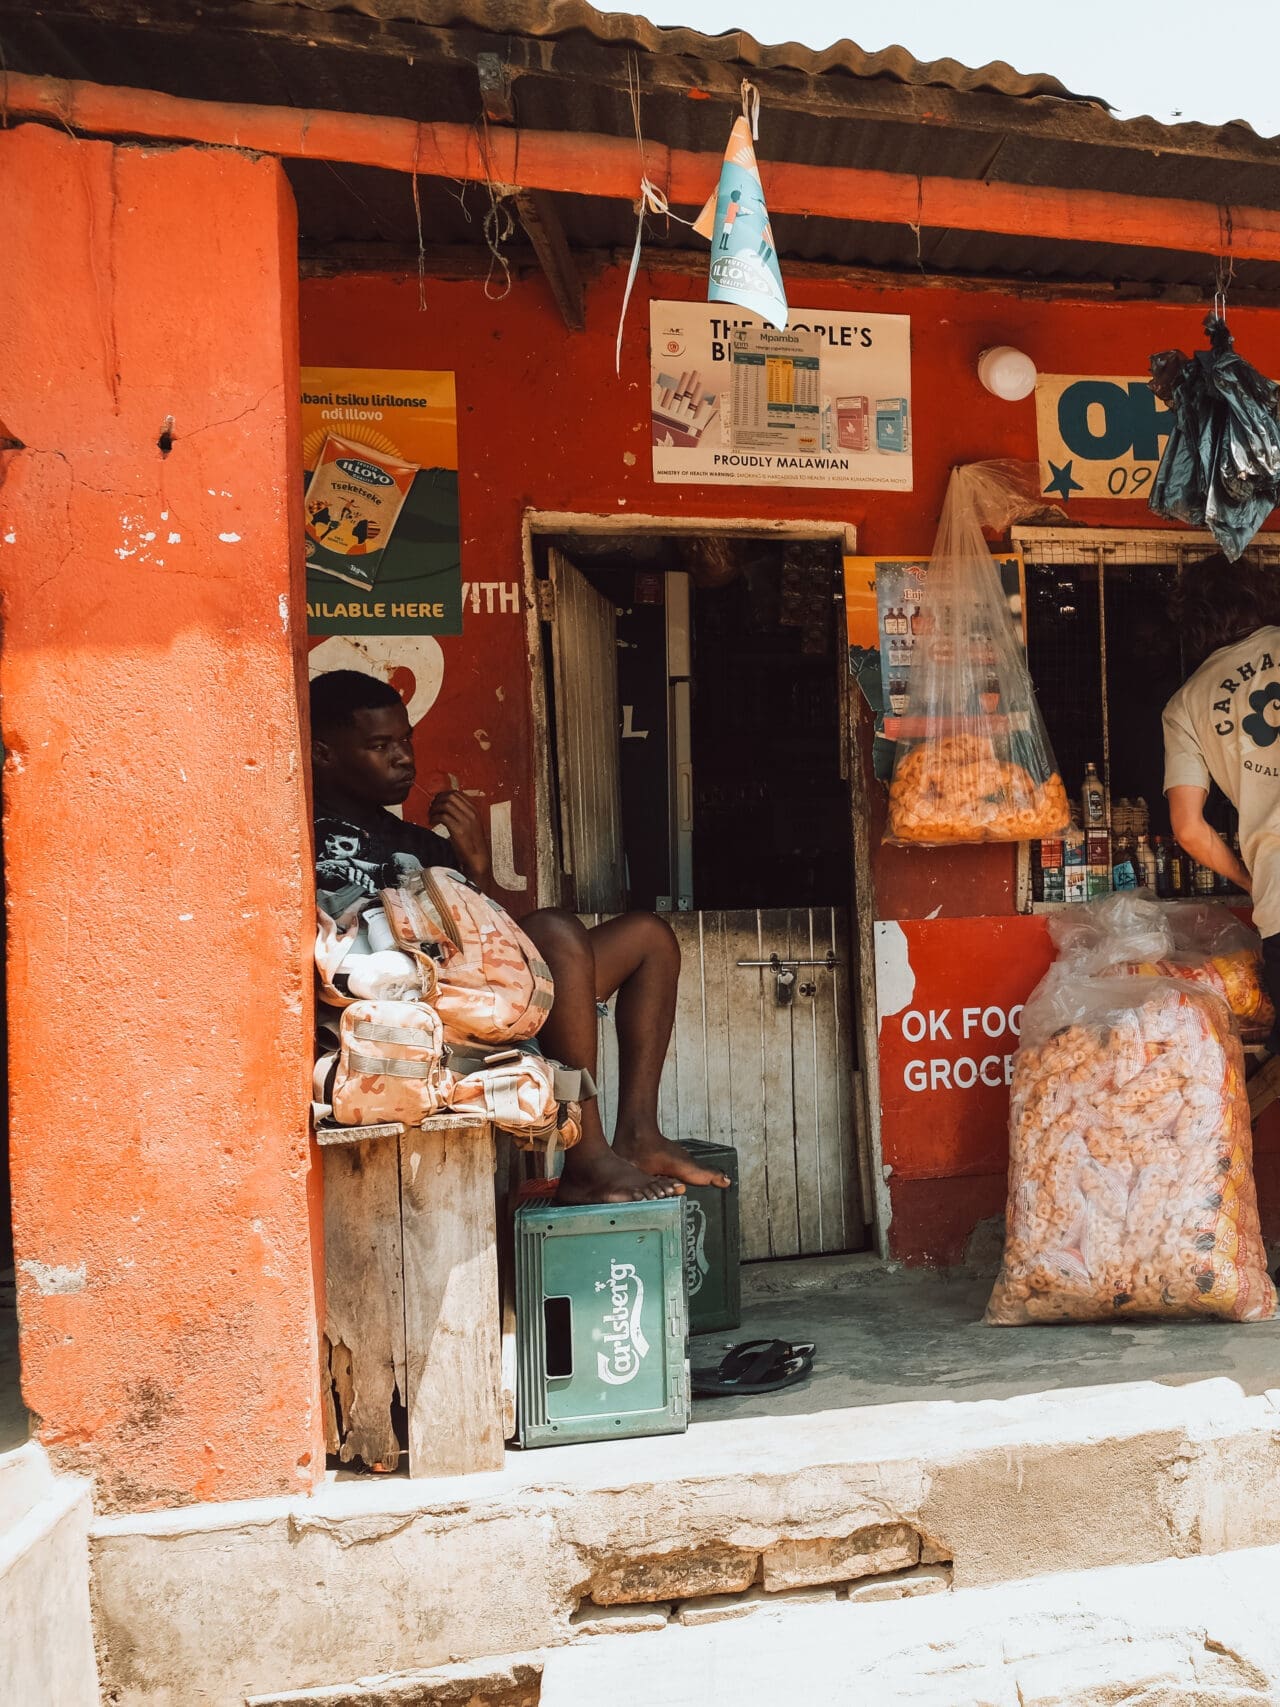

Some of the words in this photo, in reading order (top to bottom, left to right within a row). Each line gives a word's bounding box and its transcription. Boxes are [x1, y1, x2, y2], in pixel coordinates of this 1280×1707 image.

[760, 333, 799, 343] Mpamba
[300, 392, 334, 406] bani
[335, 393, 369, 407] tsiku
[321, 407, 344, 420] ndi
[345, 408, 384, 421] Illovo
[714, 454, 772, 467] PROUDLY
[776, 457, 849, 470] MALAWIAN
[342, 461, 390, 484] ILLOVO
[330, 482, 382, 506] Tseketseke
[391, 602, 445, 618] HERE
[901, 1008, 953, 1043] OK
[596, 1261, 644, 1386] Carlsberg
